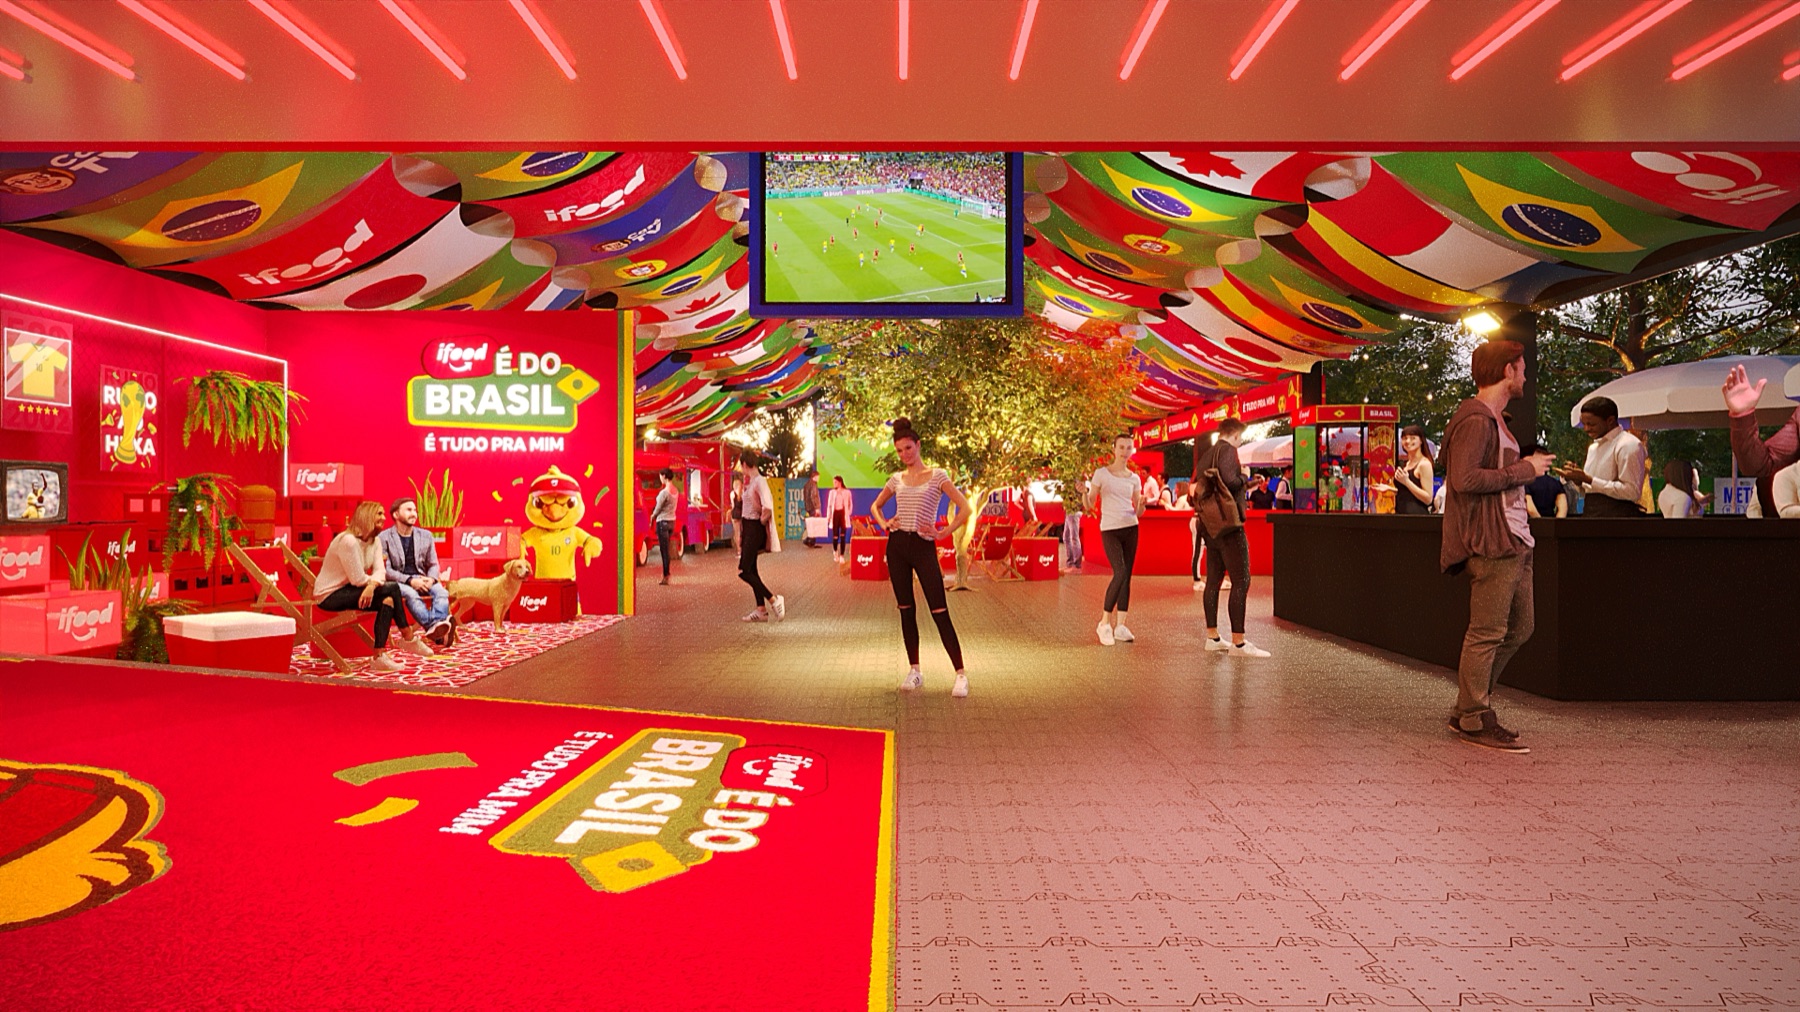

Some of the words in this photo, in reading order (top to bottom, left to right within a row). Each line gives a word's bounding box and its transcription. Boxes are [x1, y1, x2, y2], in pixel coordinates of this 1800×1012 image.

[543, 163, 646, 222] ifood
[238, 218, 374, 285] ifood
[36, 363, 43, 372] 10
[436, 343, 488, 364] ifood
[495, 345, 513, 375] É
[519, 352, 562, 375] DO
[425, 384, 565, 415] BRASIL
[105, 434, 156, 456] HXA
[424, 432, 436, 451] É
[439, 437, 488, 451] TUDO
[491, 437, 527, 451] PRA
[529, 437, 564, 451] MIM
[296, 469, 337, 485] ifood
[788, 514, 801, 526] DA
[461, 532, 502, 548] ifood
[551, 545, 561, 555] 10
[520, 595, 547, 607] ifood
[58, 602, 114, 633] ifood
[574, 731, 613, 739] É
[531, 739, 598, 770] TUDO
[487, 769, 556, 798] PRA
[554, 737, 724, 843] BRASIL
[714, 788, 794, 807] É
[439, 799, 518, 835] MIM
[688, 808, 769, 852] DO
